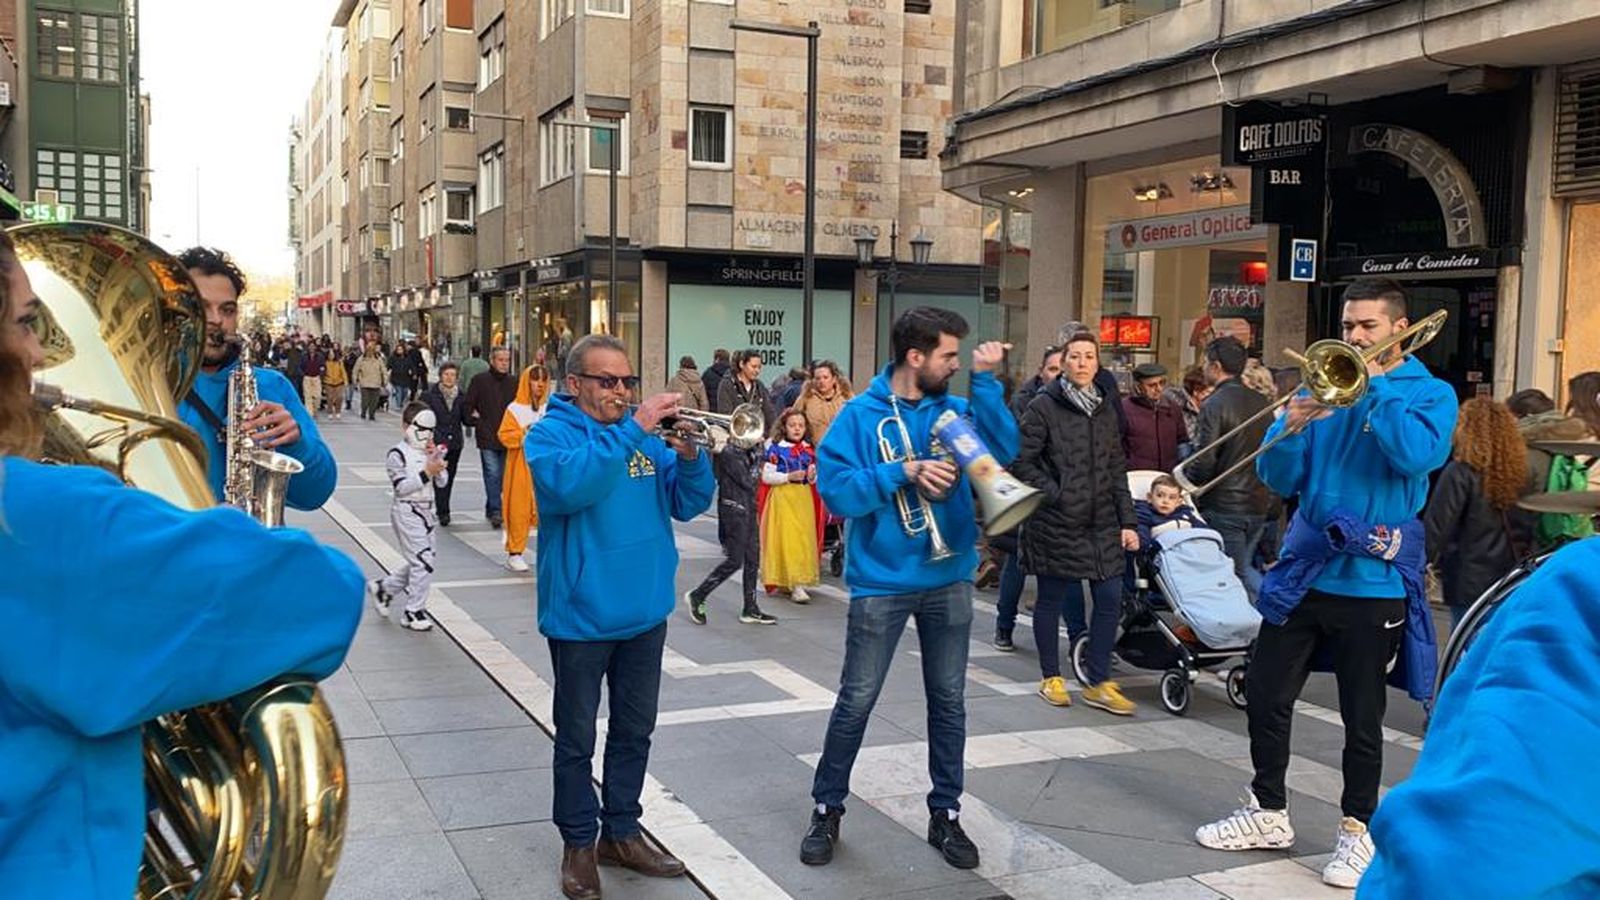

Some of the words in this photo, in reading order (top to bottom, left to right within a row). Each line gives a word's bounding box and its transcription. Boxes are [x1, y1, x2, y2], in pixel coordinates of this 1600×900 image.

[1240, 123, 1272, 152] CAFE
[1274, 118, 1322, 147] DOLFOS
[1269, 169, 1301, 185] BAR
[737, 217, 817, 236] ALMACEN
[1141, 219, 1197, 243] General
[1202, 213, 1253, 238] Optica
[1296, 246, 1313, 262] CB
[1362, 258, 1393, 273] Casa
[1395, 257, 1414, 271] de
[1416, 253, 1480, 270] Comidas
[722, 267, 804, 281] SPRINGFIELD
[744, 309, 785, 326] ENJOY
[748, 329, 782, 346] YOUR
[756, 349, 785, 366] ORE
[1217, 811, 1287, 841] AIR
